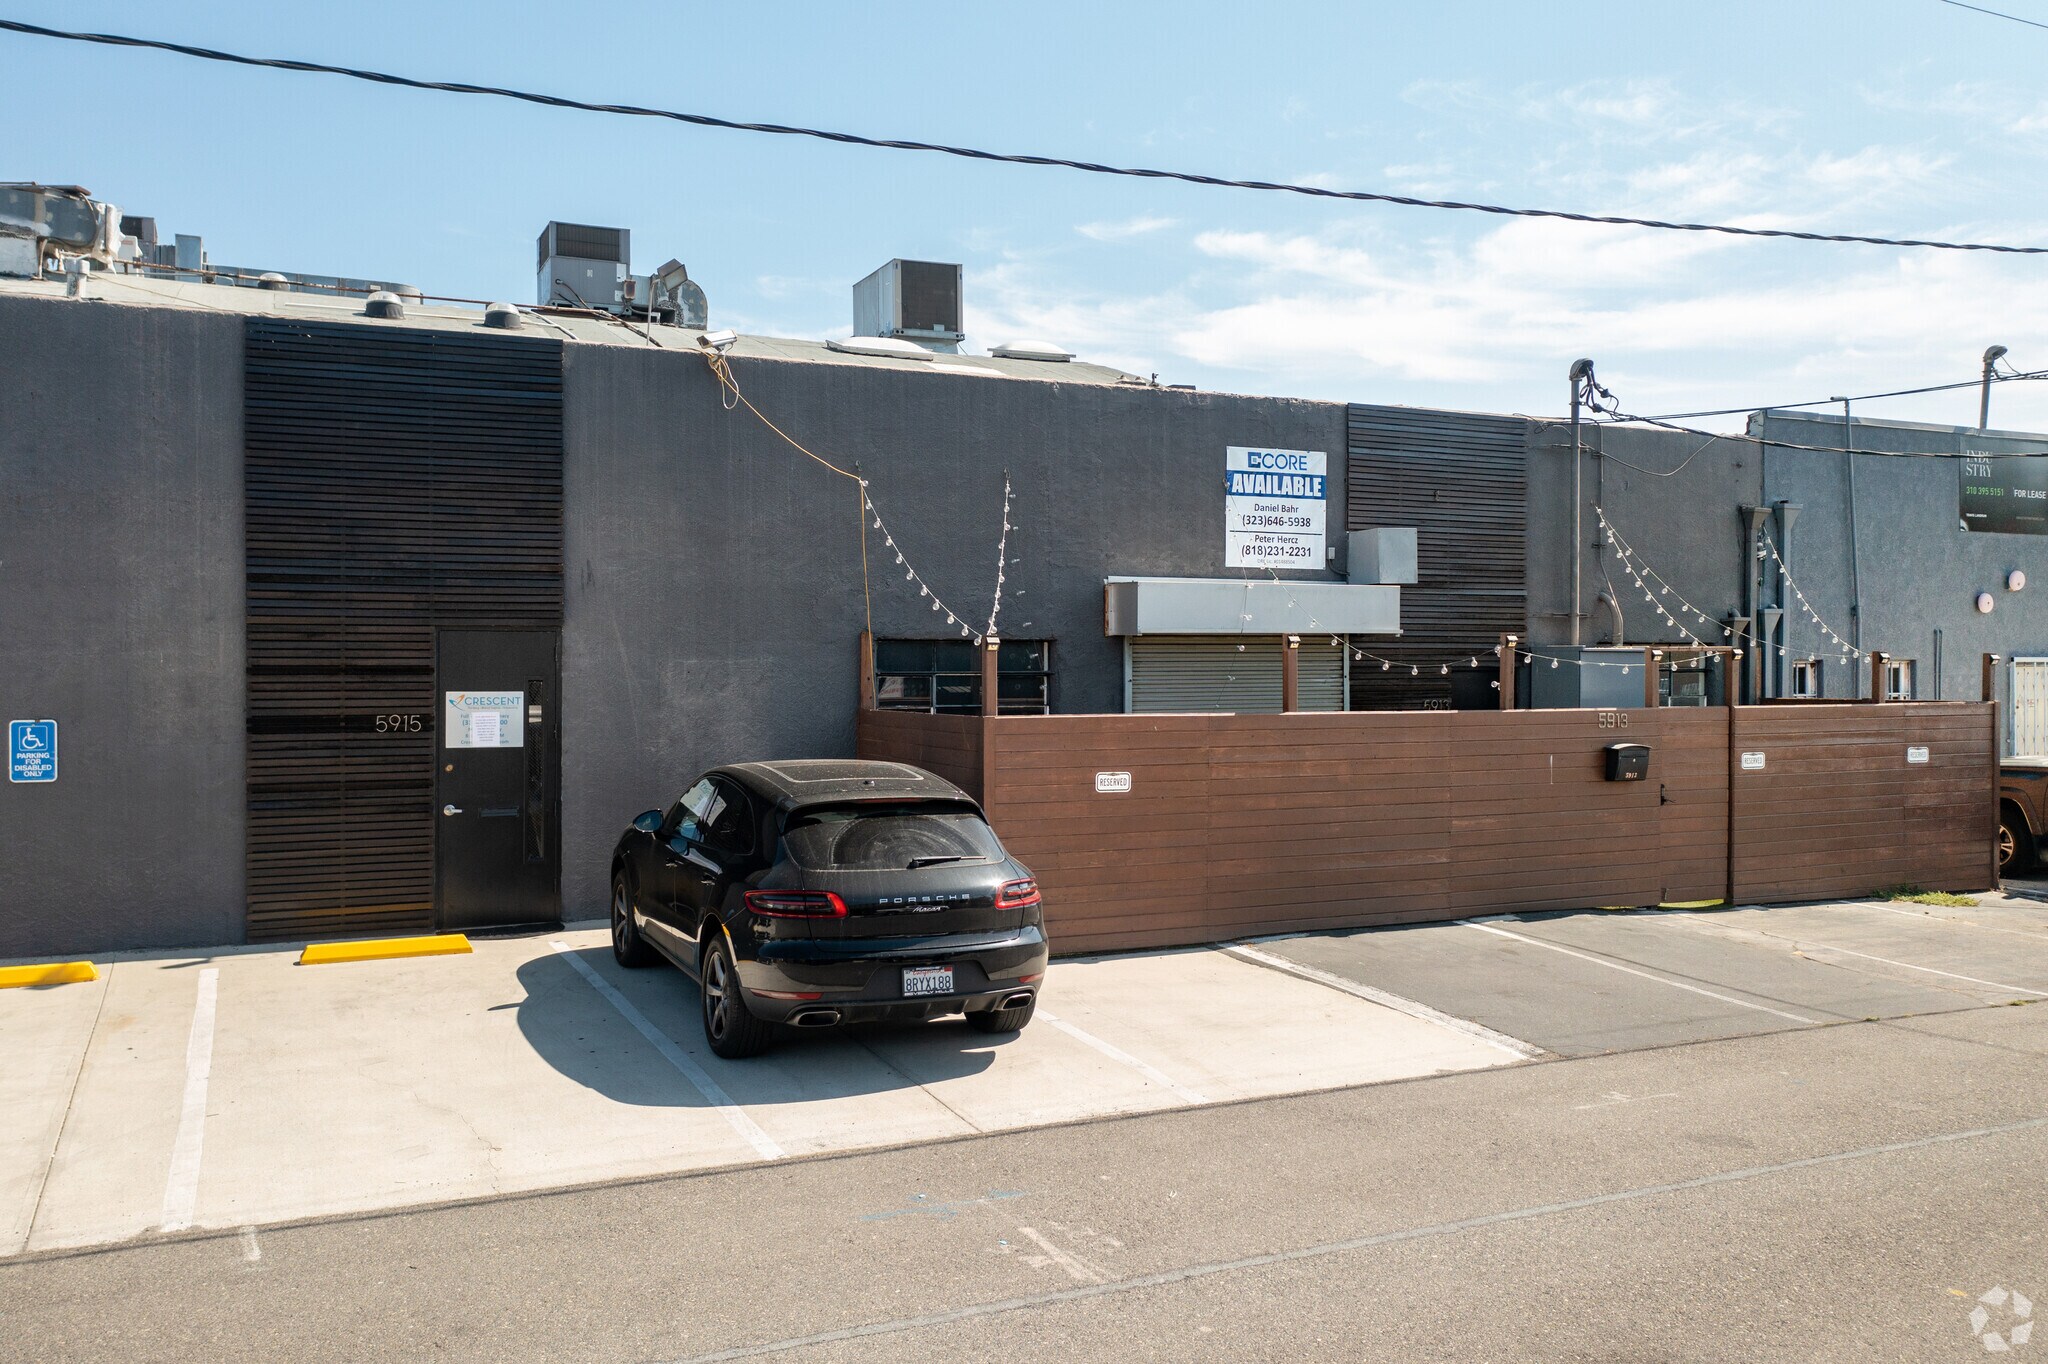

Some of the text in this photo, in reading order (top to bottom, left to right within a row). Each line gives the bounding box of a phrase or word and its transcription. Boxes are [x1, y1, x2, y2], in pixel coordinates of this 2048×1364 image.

[1262, 453, 1307, 470] CORE
[1966, 464, 1993, 478] STRY
[1231, 473, 1322, 497] AVAILABLE
[1966, 486, 2004, 496] 310 395 5151
[2014, 489, 2046, 500] FOR LEASE
[1254, 503, 1299, 514] Daniel Bahr
[1242, 515, 1311, 528] (323)646-5938
[1254, 534, 1298, 544] Peter Hercz
[1241, 545, 1312, 558] (818)231-2231
[464, 696, 521, 706] CRESCENT
[376, 714, 422, 732] 5915
[1598, 712, 1628, 728] 5913
[1100, 778, 1128, 786] RESERVED
[879, 894, 970, 904] PORSCHE
[906, 975, 951, 992] 8RYX188
